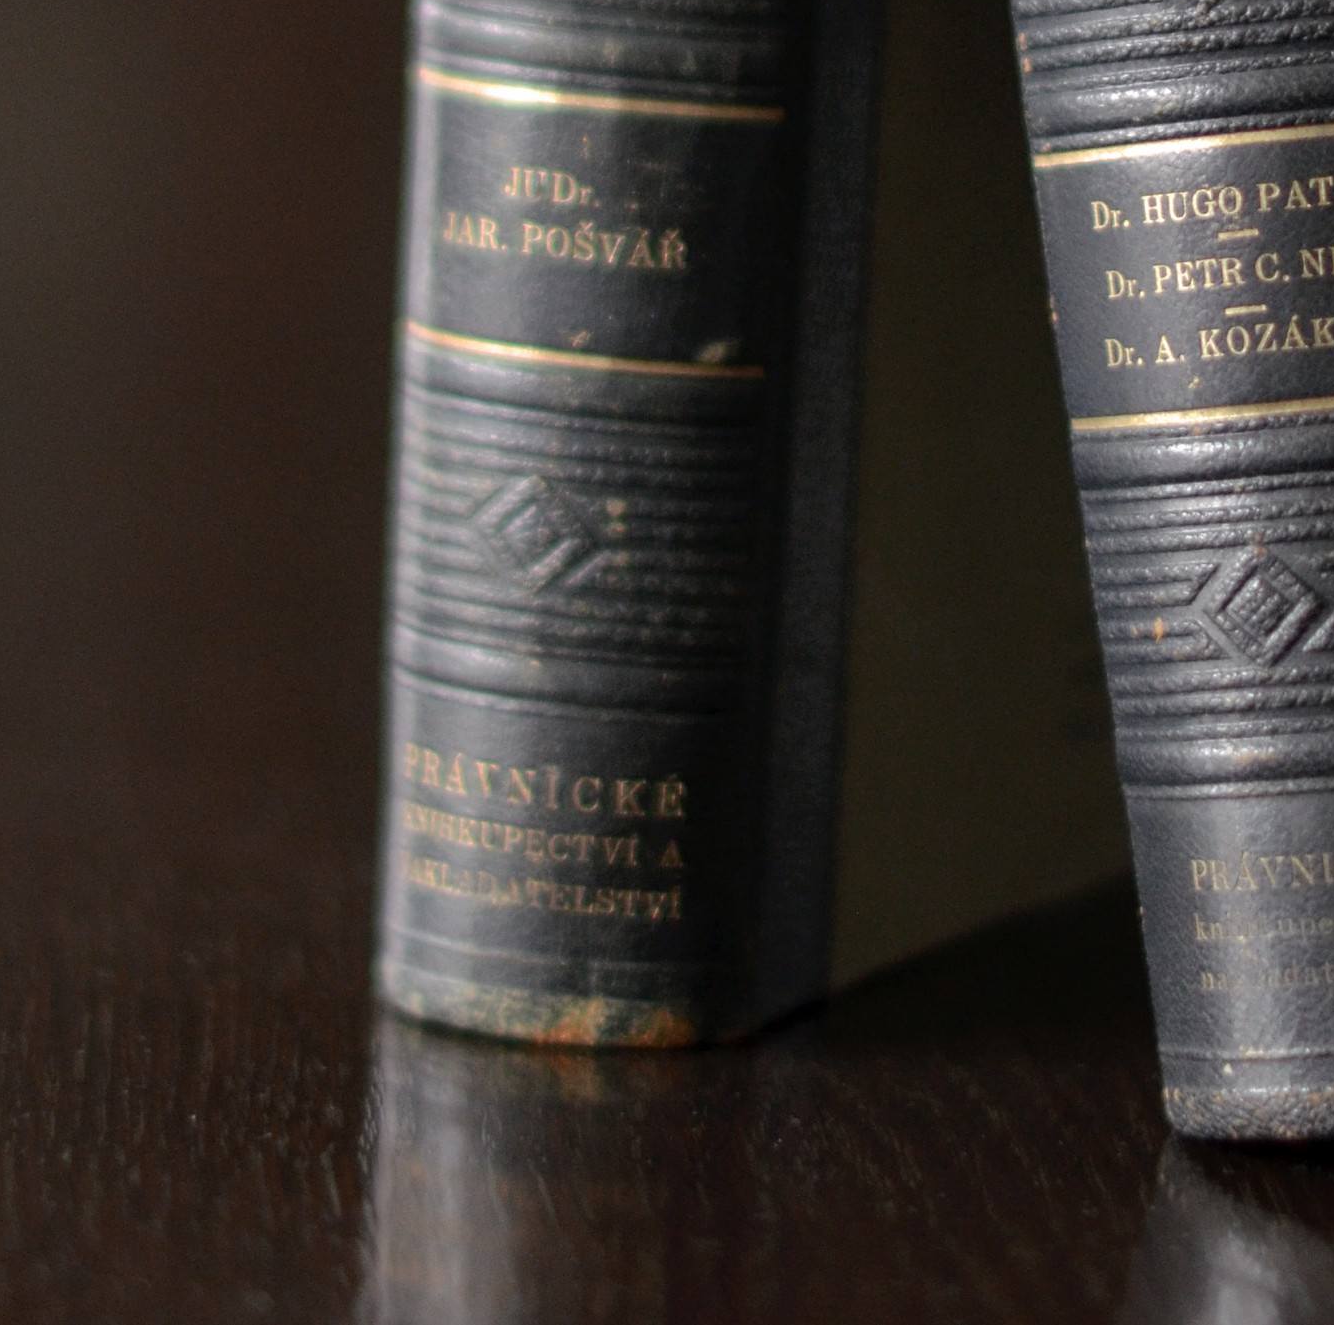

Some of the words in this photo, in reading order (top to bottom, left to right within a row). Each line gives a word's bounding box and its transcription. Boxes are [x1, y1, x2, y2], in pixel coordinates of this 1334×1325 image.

[503, 167, 601, 209] JUDr.
[1091, 200, 1131, 231] Dr.
[1142, 187, 1244, 225] HUGO
[442, 211, 509, 252] JAR.
[522, 221, 689, 269] POŠVÁŘ
[1106, 270, 1146, 299] Dr.
[1153, 256, 1246, 294] PETR
[1255, 252, 1291, 282] C.
[1105, 338, 1144, 368] Dr.
[1155, 335, 1186, 364] A.
[405, 741, 688, 819] PRÁVNICKÉ
[659, 839, 684, 870] A
